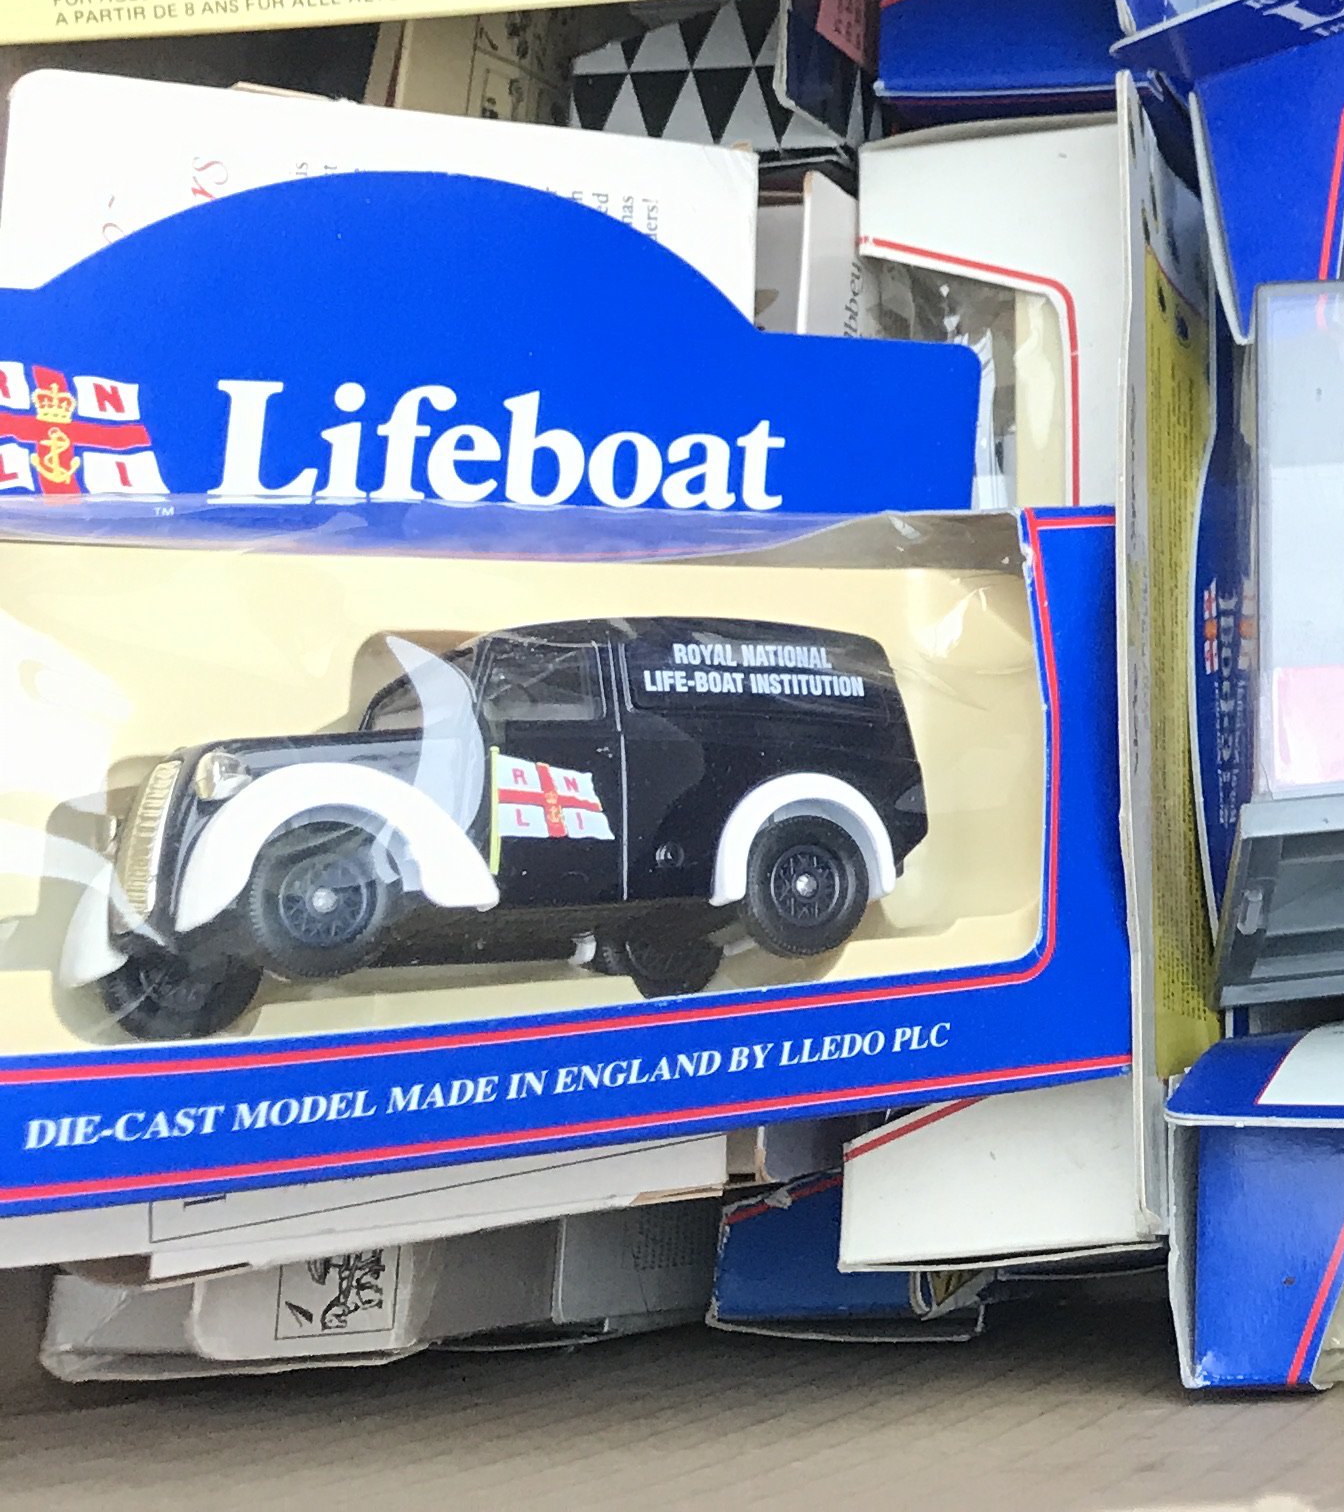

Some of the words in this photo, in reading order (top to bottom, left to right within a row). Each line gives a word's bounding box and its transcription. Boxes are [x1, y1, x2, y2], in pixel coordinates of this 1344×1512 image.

[73, 5, 147, 25] PARTIR
[153, 2, 180, 21] DE
[184, 1, 196, 18] 8
[206, 378, 786, 513] Lifeboat
[673, 643, 737, 668] ROYAL
[742, 645, 833, 670] NATIONAL
[644, 670, 745, 695] LIFE-BOAT
[750, 672, 865, 699] INSTITUTION
[23, 1102, 218, 1153] DIE-CAST
[232, 1088, 376, 1133] MODEL
[387, 1074, 499, 1115] MADE
[505, 1068, 546, 1099] IN
[550, 1047, 721, 1096] ENGLAND
[727, 1041, 774, 1074] BY
[779, 1030, 886, 1068] LLEDO
[890, 1020, 952, 1053] PLC
